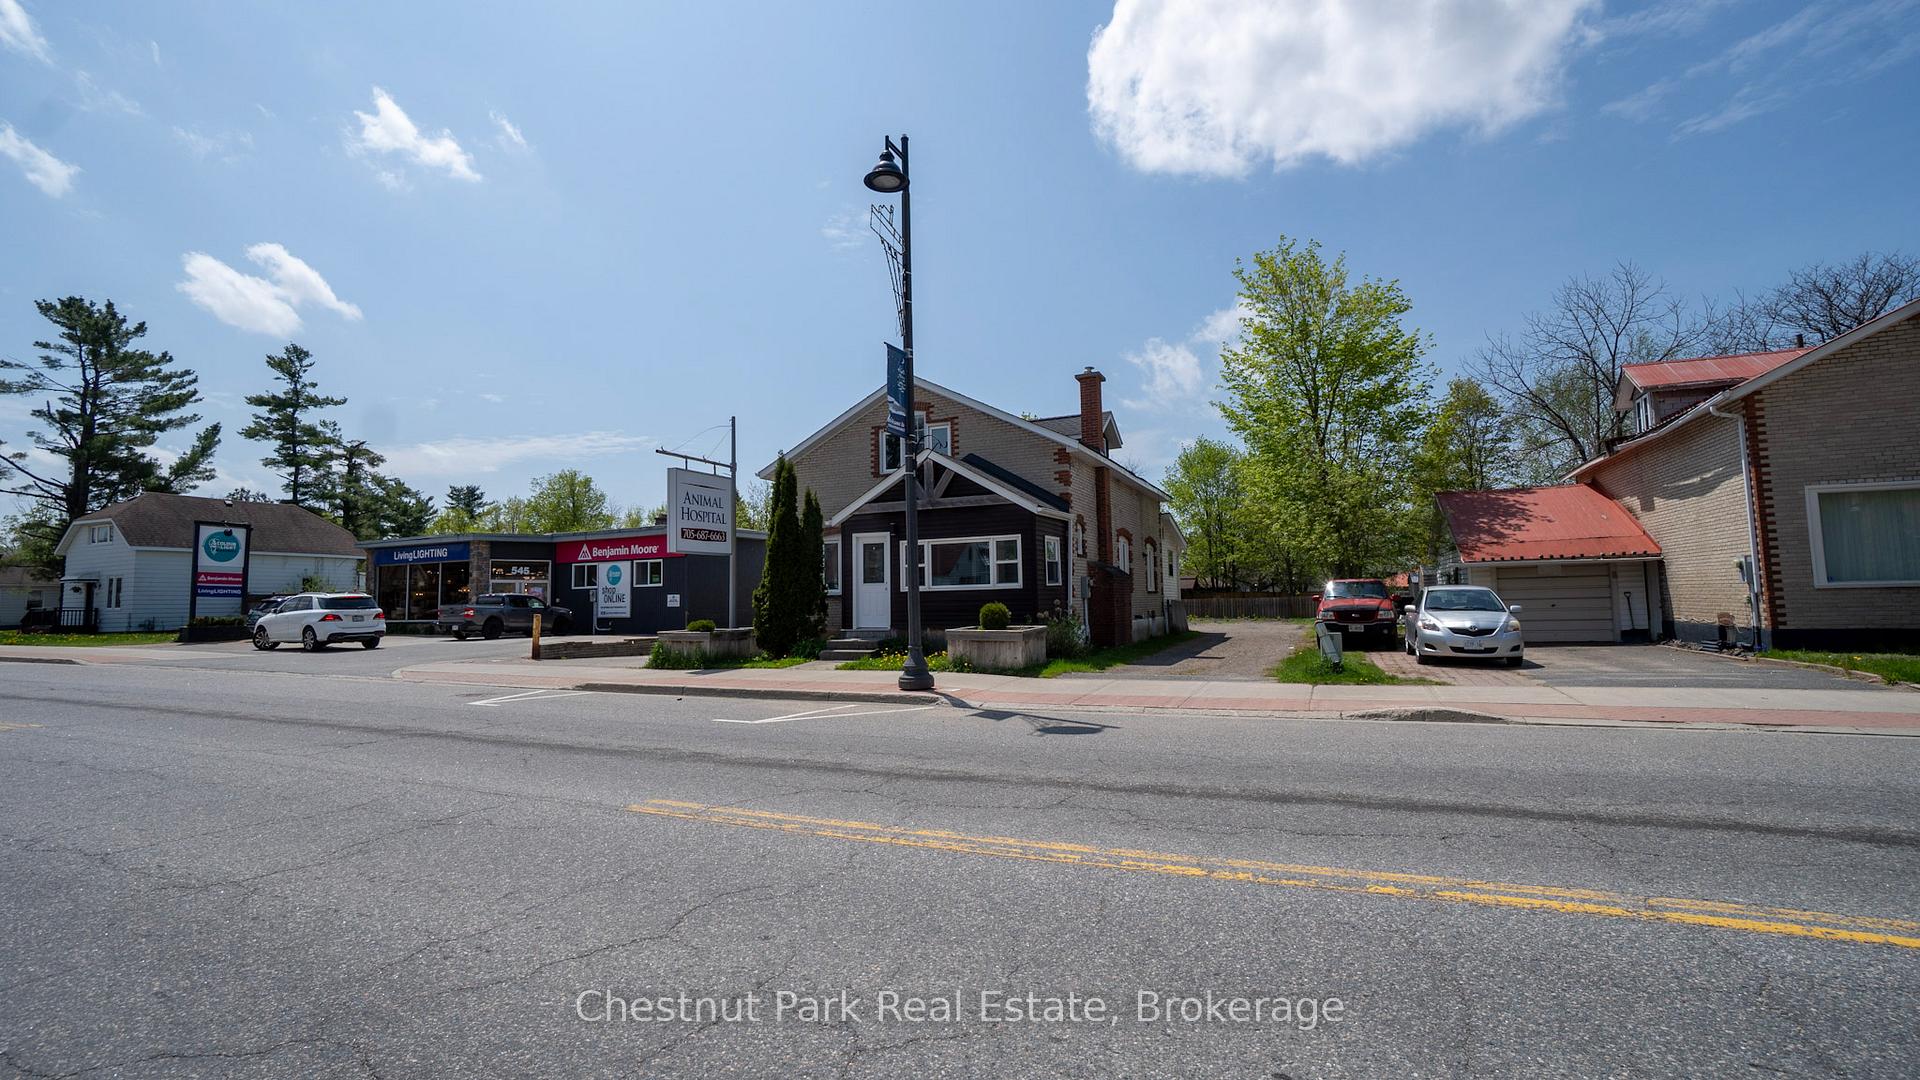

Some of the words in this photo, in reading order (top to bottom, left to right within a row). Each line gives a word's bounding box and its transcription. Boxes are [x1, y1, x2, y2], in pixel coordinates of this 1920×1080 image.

[683, 491, 724, 509] ANIMAL
[681, 506, 727, 524] HOSPITAL
[683, 528, 725, 541] 705-687-6663
[592, 545, 629, 558] Benjamin
[511, 566, 530, 575] 545
[602, 586, 616, 595] shop
[604, 593, 626, 603] ONLINE
